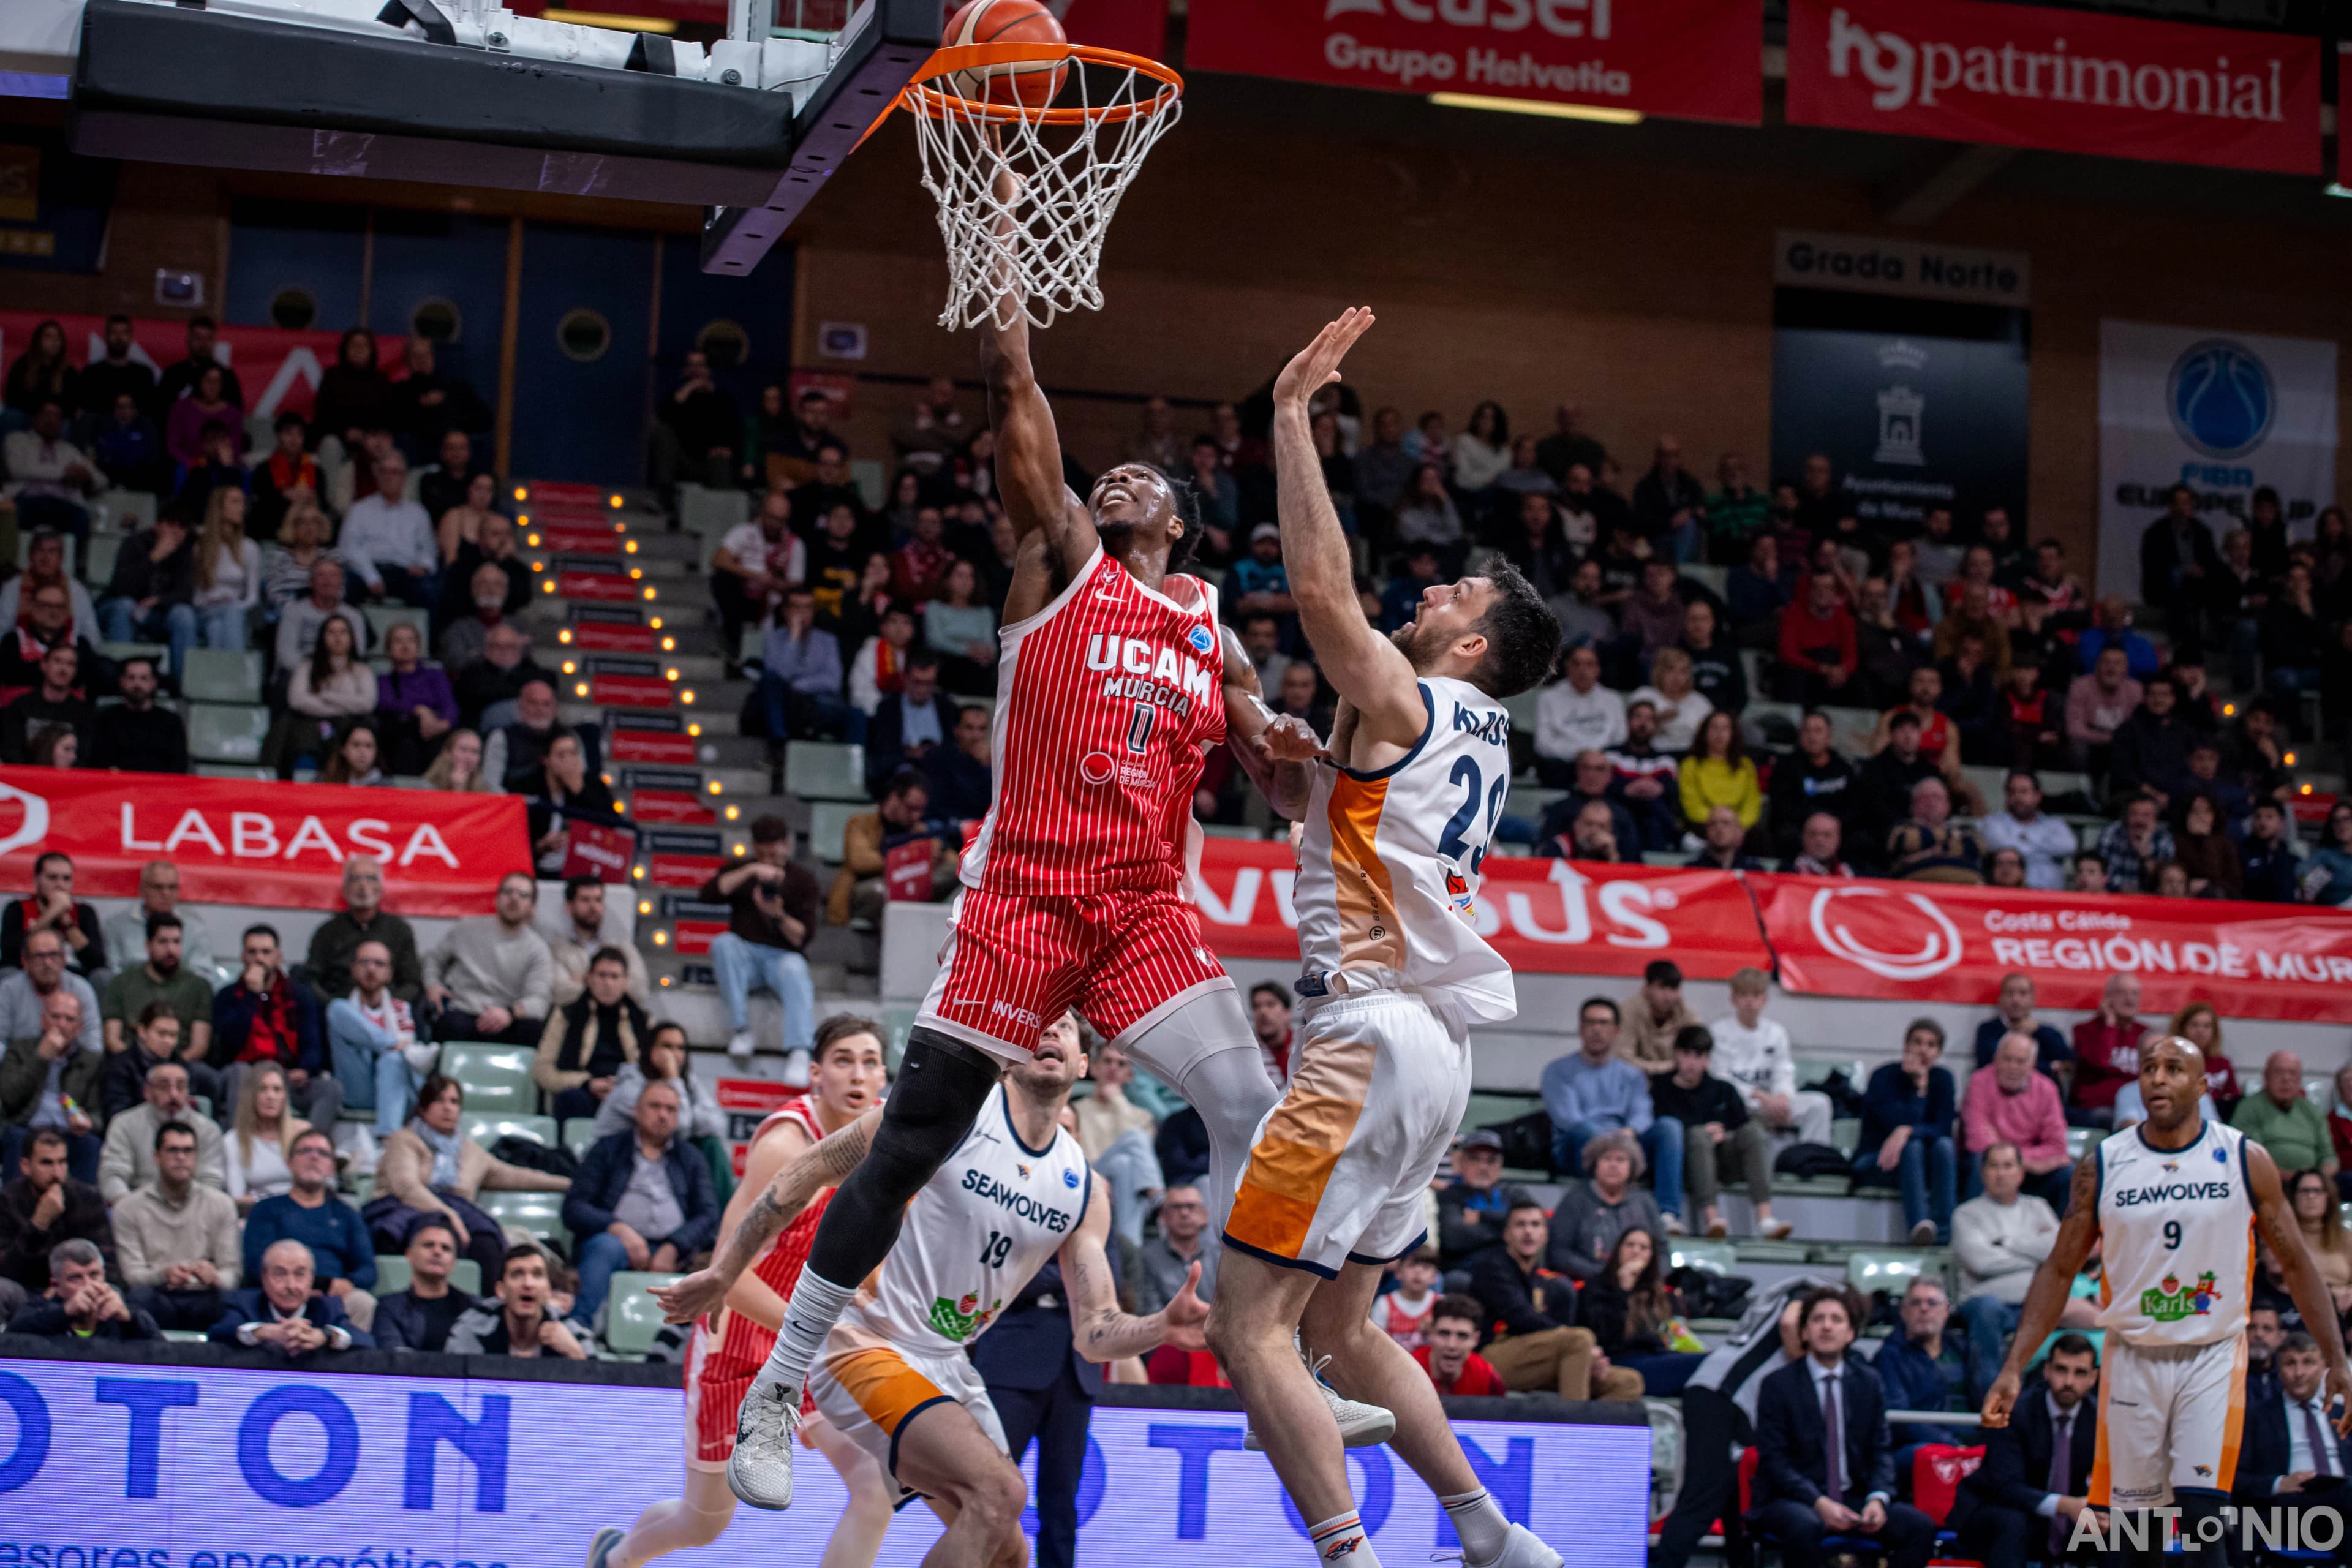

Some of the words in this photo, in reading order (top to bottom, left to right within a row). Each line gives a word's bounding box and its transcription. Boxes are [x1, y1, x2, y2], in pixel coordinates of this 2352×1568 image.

[1323, 32, 1458, 85] Grupo
[1464, 45, 1632, 96] Helvetia
[1787, 243, 1904, 281] Grada
[1920, 255, 2018, 293] Norte
[1087, 633, 1212, 707] UCAM
[1103, 676, 1190, 718] MURCIA
[1125, 702, 1155, 755] 0
[1119, 775, 1131, 785] DE
[1120, 766, 1148, 780] REGIÓN
[122, 801, 461, 869] LABASA
[1437, 754, 1507, 876] 29
[1985, 909, 2052, 933] Costa
[2057, 908, 2133, 932] Cálida
[1992, 931, 2174, 973] REGIÓN
[2180, 941, 2248, 978] DE
[962, 1168, 1071, 1234] SEAWOLVES
[2115, 1182, 2230, 1207] SEAWOLVES
[979, 1231, 1012, 1269] 19
[2163, 1221, 2182, 1251] 9
[2145, 1292, 2196, 1314] Karls
